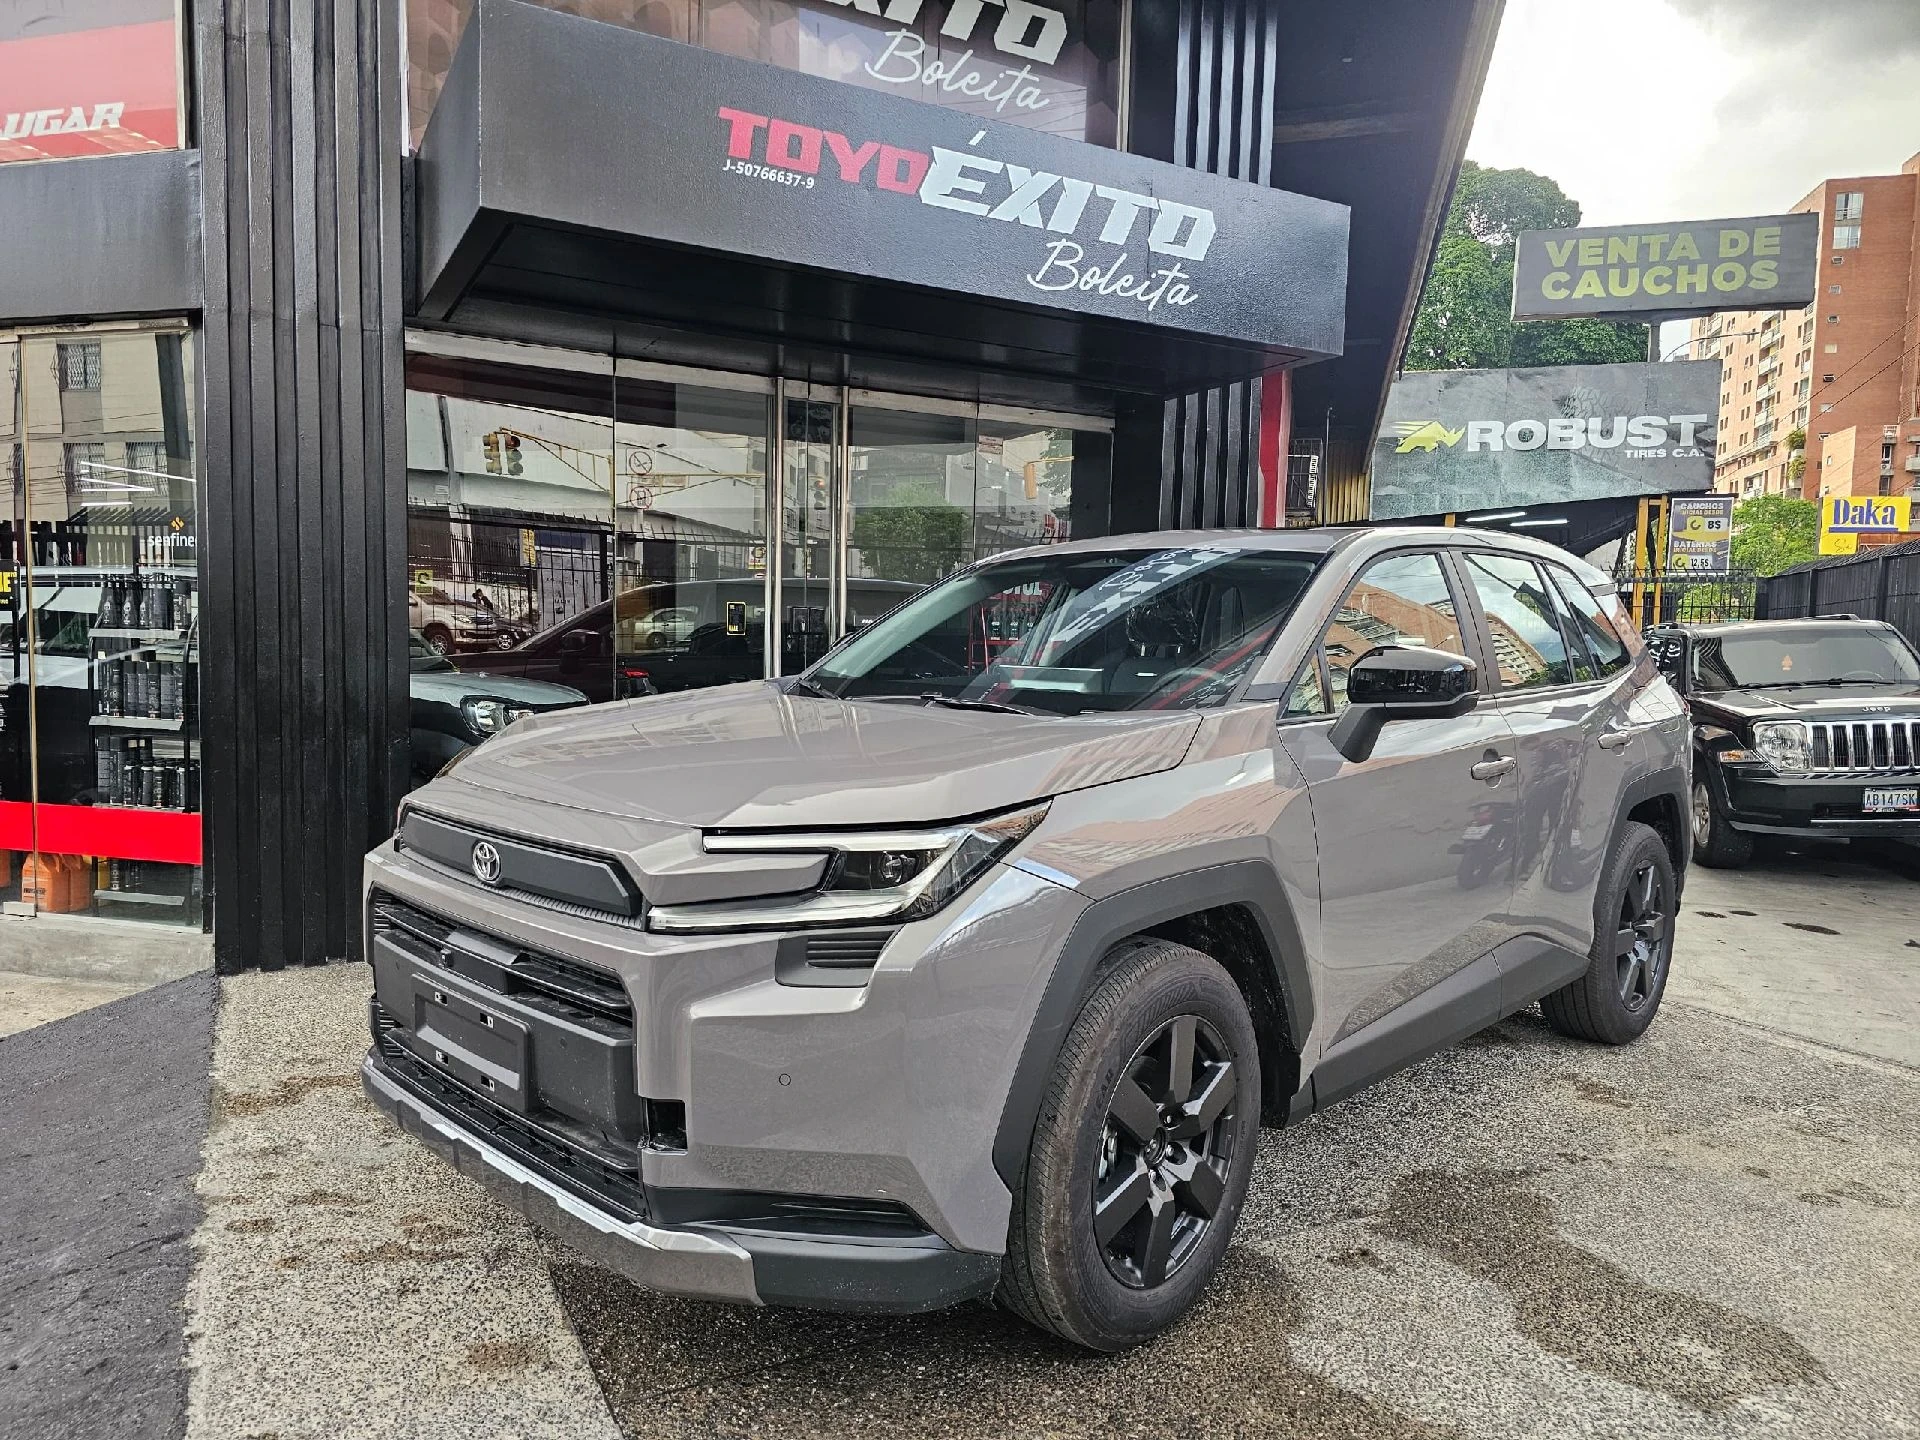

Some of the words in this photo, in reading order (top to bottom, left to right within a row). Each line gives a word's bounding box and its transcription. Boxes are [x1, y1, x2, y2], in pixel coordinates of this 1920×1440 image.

[865, 28, 1050, 112] Boleita
[722, 159, 815, 189] J-50766637-9
[1544, 232, 1701, 268] VENTA
[1718, 226, 1782, 259] DE
[1026, 238, 1199, 312] Boleita
[1541, 259, 1780, 300] CAUCHOS
[1467, 413, 1708, 452] ROBUST
[1624, 447, 1667, 458] TIRES
[1671, 446, 1705, 458] C.A.
[1680, 502, 1724, 510] CAUCHOS
[1833, 498, 1896, 525] Daka
[148, 532, 197, 547] senfine
[1865, 793, 1916, 807] AB147SK
